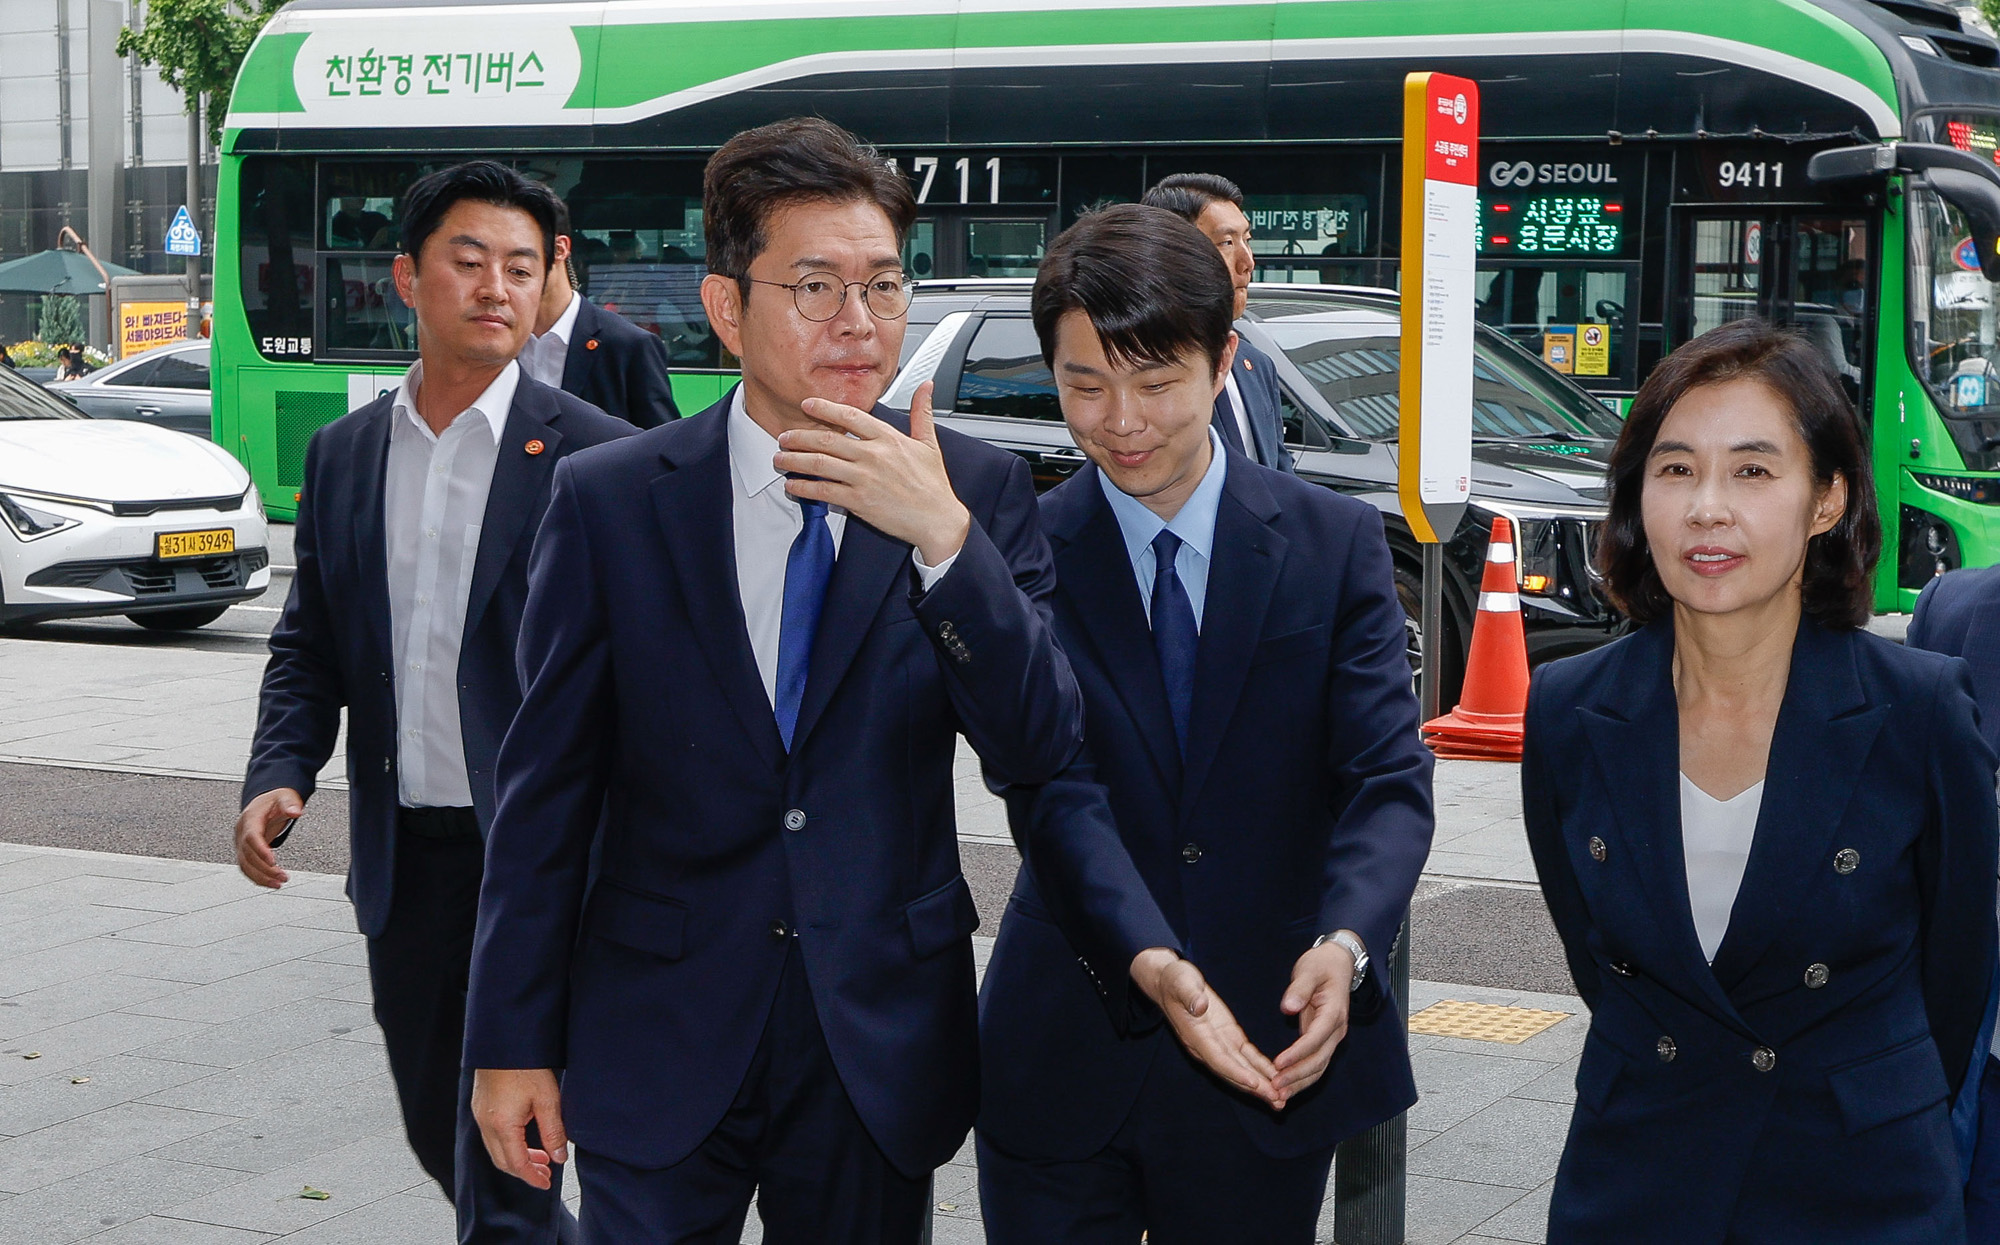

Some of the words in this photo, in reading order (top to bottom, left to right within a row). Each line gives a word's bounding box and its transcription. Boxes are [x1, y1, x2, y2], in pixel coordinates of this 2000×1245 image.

[326, 48, 412, 97] 친환경
[422, 51, 545, 95] 전기버스
[885, 157, 1000, 204] 711
[1538, 163, 1618, 184] SEOUL
[1718, 161, 1783, 188] 9411
[1522, 198, 1602, 225] 시청앞
[1517, 225, 1619, 251] 용문시장
[125, 314, 140, 329] 와!
[261, 336, 313, 356] 도원교통
[198, 532, 229, 552] 3949
